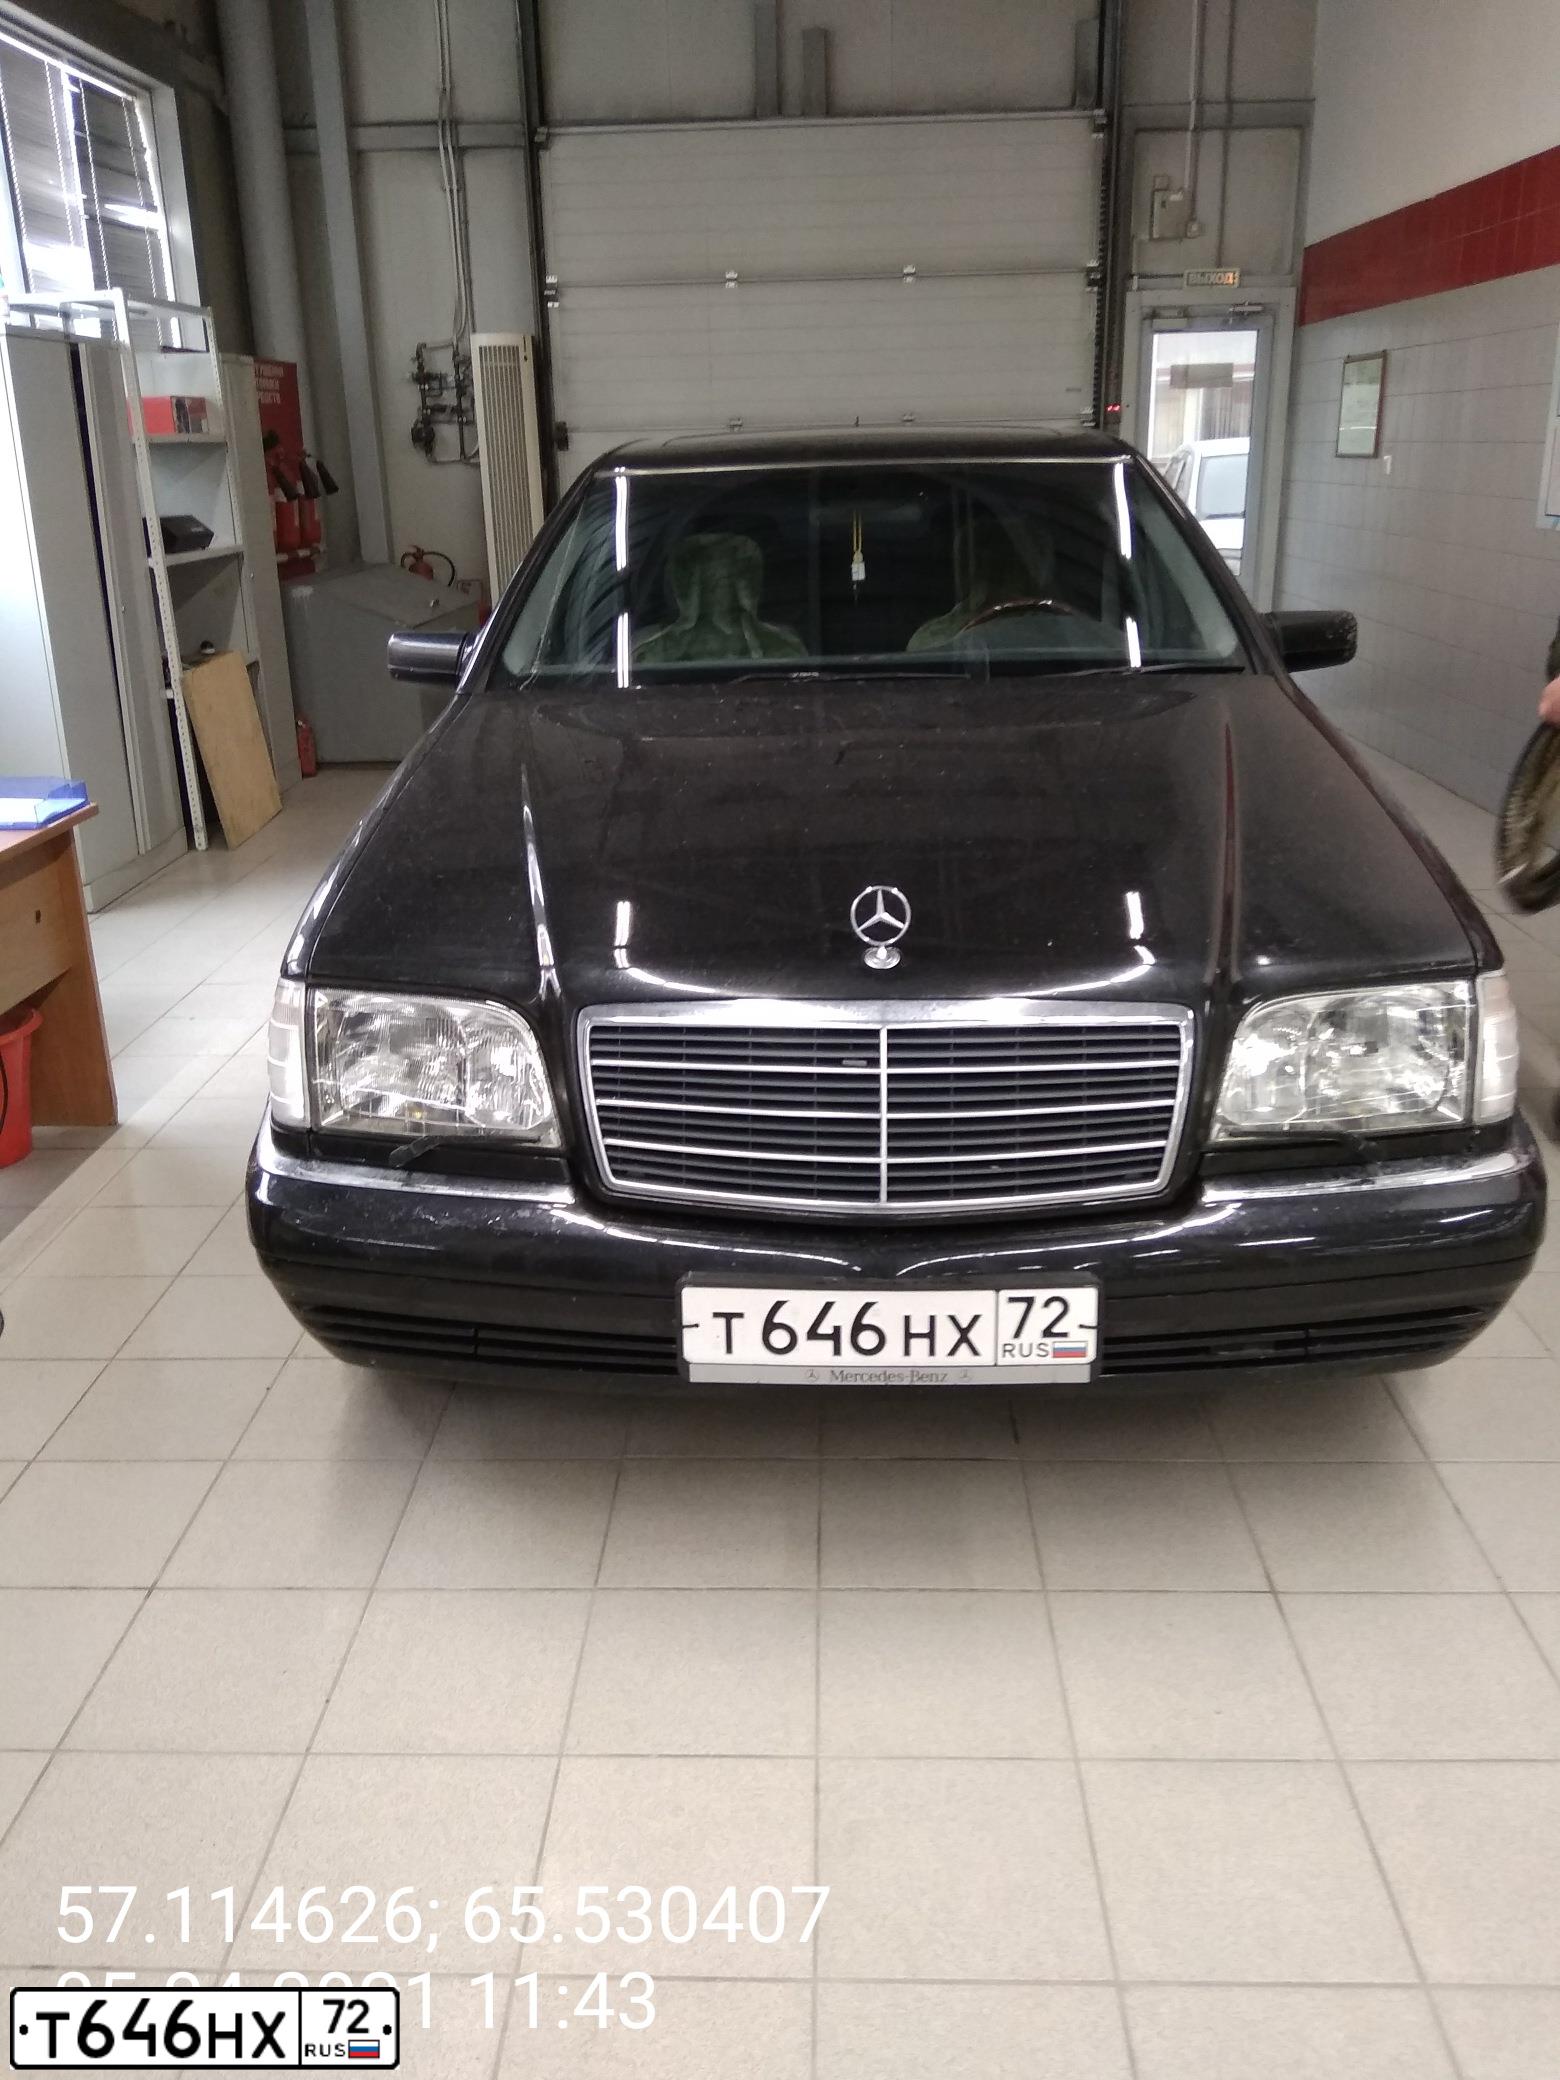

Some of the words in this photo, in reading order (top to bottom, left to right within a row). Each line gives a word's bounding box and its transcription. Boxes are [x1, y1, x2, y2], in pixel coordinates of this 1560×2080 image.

[1007, 1296, 1070, 1339] 72
[1002, 1343, 1049, 1358] RUS
[831, 1370, 948, 1383] Mercedes-Benz
